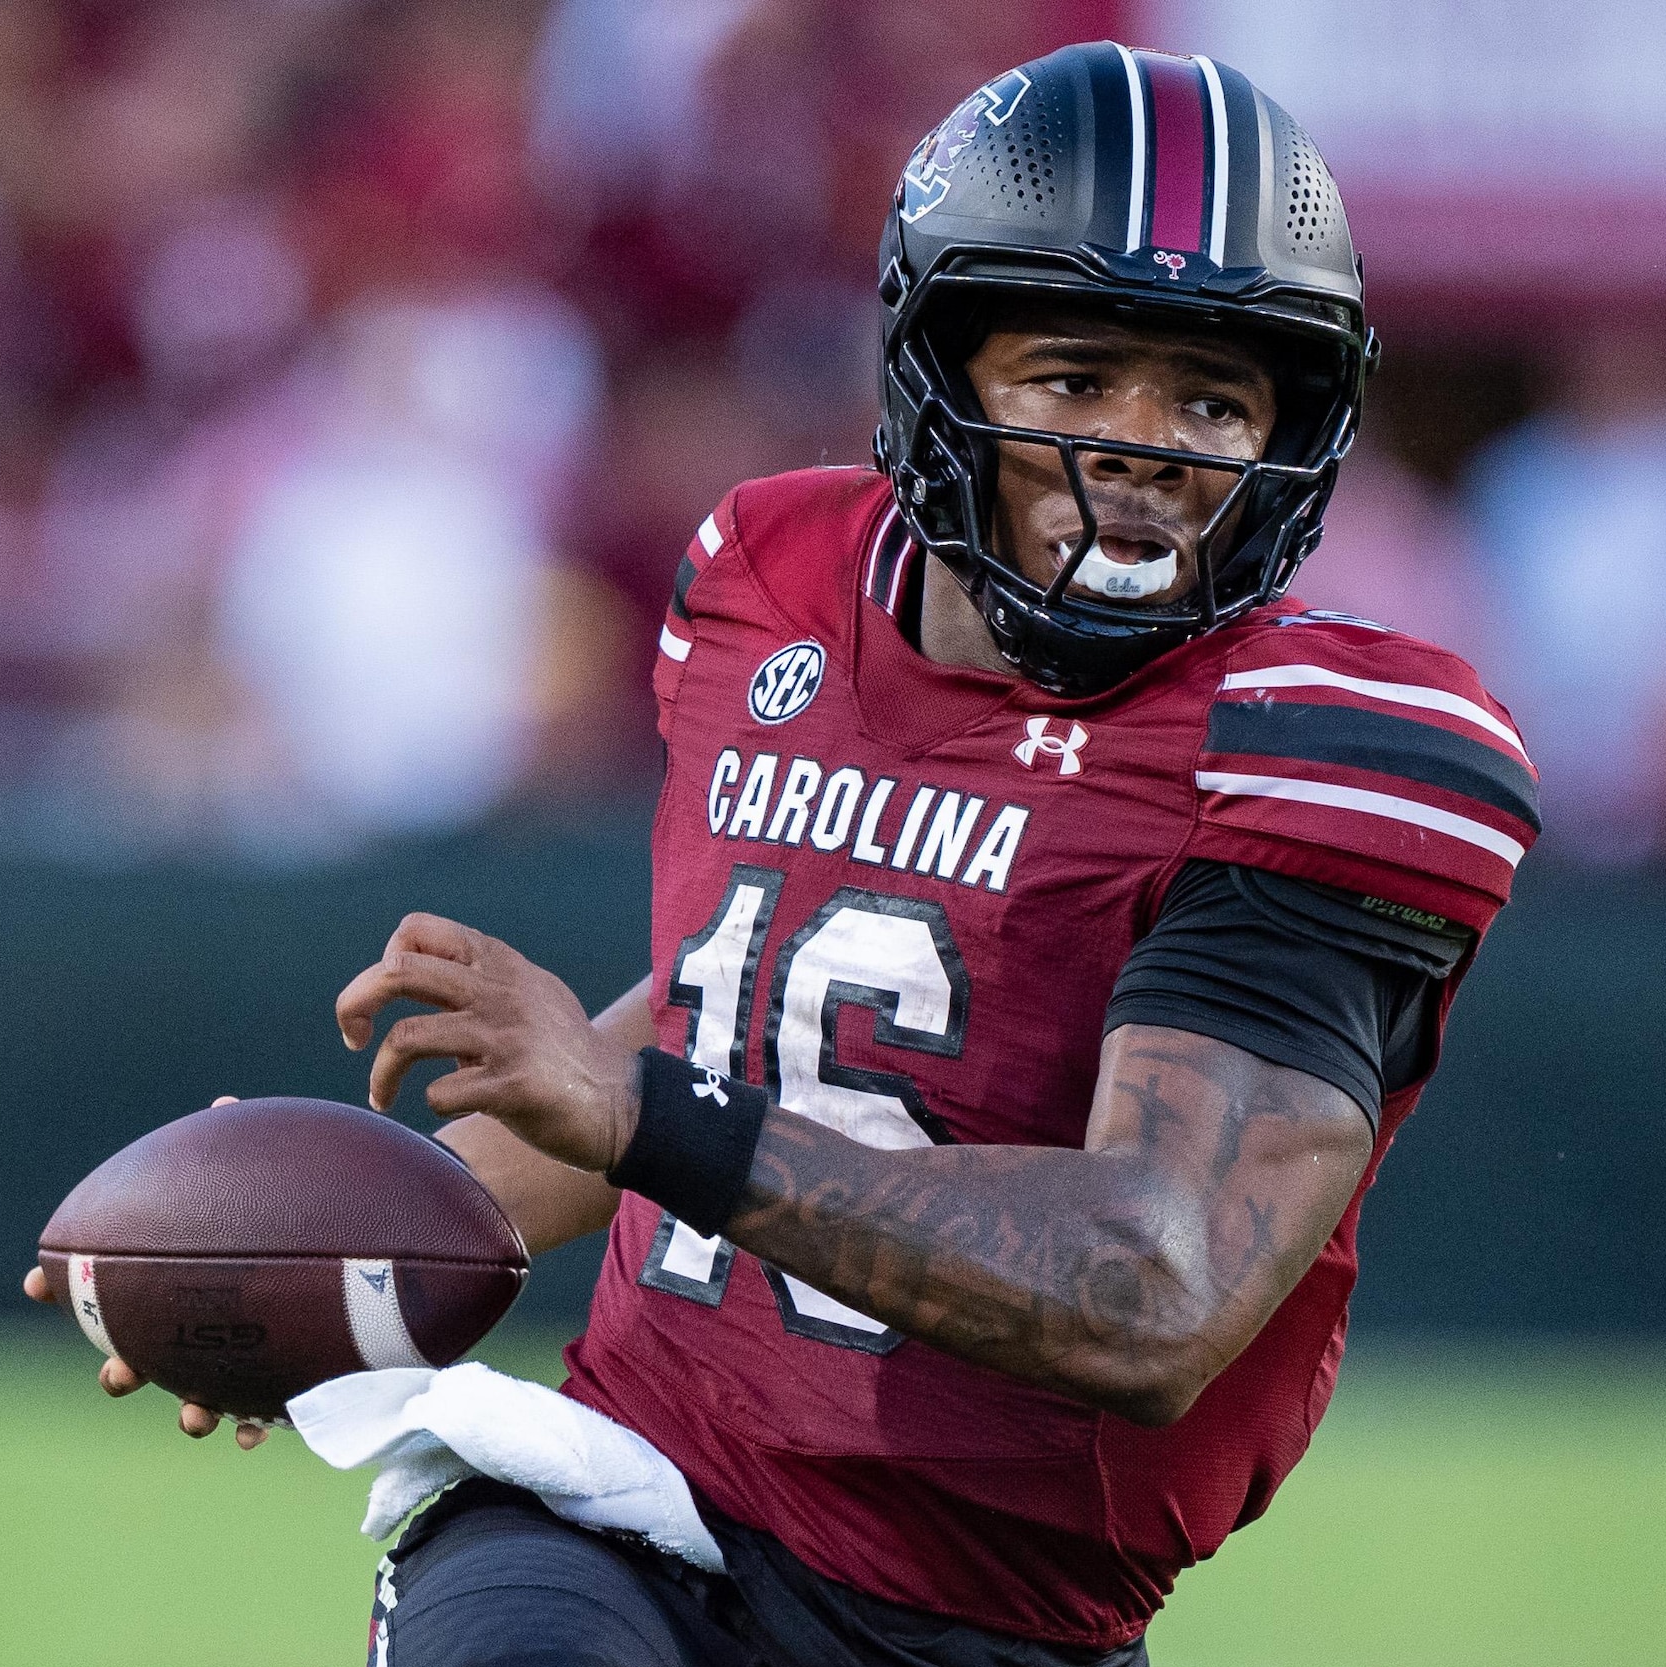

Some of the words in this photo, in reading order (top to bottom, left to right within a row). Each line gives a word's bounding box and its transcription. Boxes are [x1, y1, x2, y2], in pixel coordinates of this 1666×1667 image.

[753, 647, 820, 718] SEC
[707, 746, 1032, 894] CAROLINA
[637, 862, 971, 1356] 16
